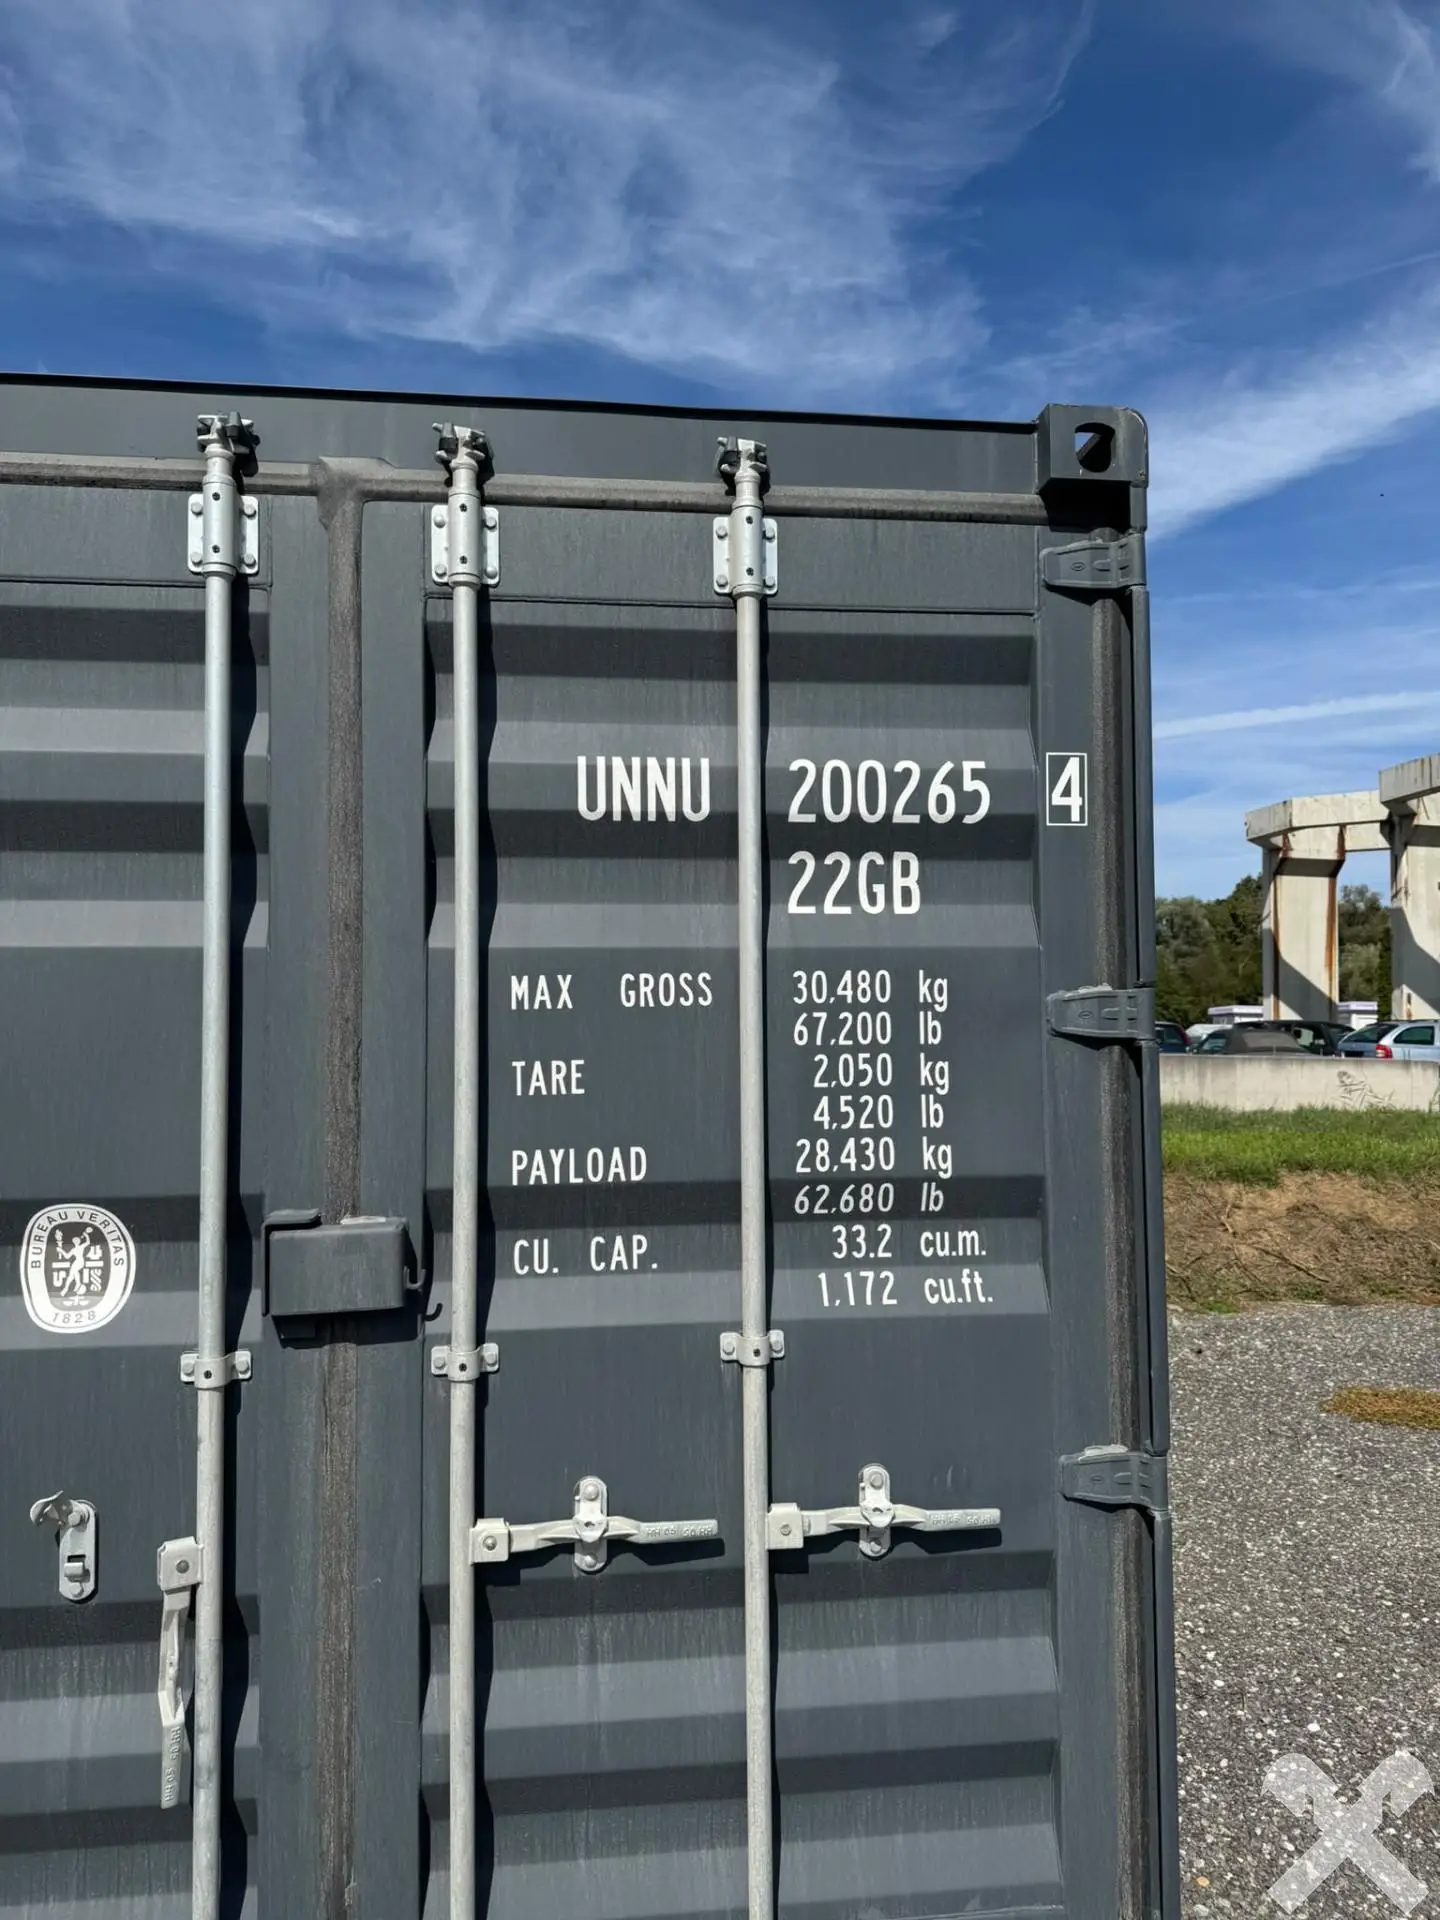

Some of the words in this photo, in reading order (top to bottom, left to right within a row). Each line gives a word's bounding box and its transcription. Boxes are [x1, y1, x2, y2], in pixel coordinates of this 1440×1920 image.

[576, 755, 711, 822] UNNU
[788, 758, 991, 824] 200265
[1051, 757, 1083, 822] 4
[787, 851, 921, 915] 22GB
[510, 974, 573, 1011] MAX
[620, 971, 713, 1008] GROSS
[792, 969, 891, 1005] 30,480
[918, 969, 949, 1013] kg
[793, 1010, 892, 1046] 67,200
[919, 1011, 942, 1045] lb
[511, 1059, 585, 1097] TARE
[813, 1052, 893, 1088] 2,050
[919, 1052, 950, 1095] kg
[813, 1094, 894, 1130] 4,520
[920, 1094, 945, 1129] lb
[511, 1146, 647, 1186] PAYLOAD
[795, 1136, 895, 1173] 28,430
[921, 1135, 953, 1179] kg
[794, 1182, 895, 1215] 62,680
[920, 1181, 944, 1212] lb
[31, 1211, 68, 1269] BUREAU
[76, 1211, 124, 1266] VERITAS
[513, 1238, 559, 1276] CU.
[590, 1234, 658, 1272] CAP.
[831, 1223, 893, 1259] 33.2
[920, 1230, 987, 1258] cu.m.
[817, 1270, 898, 1307] 1,172
[924, 1268, 994, 1305] cu.ft.
[52, 1311, 96, 1324] 1828
